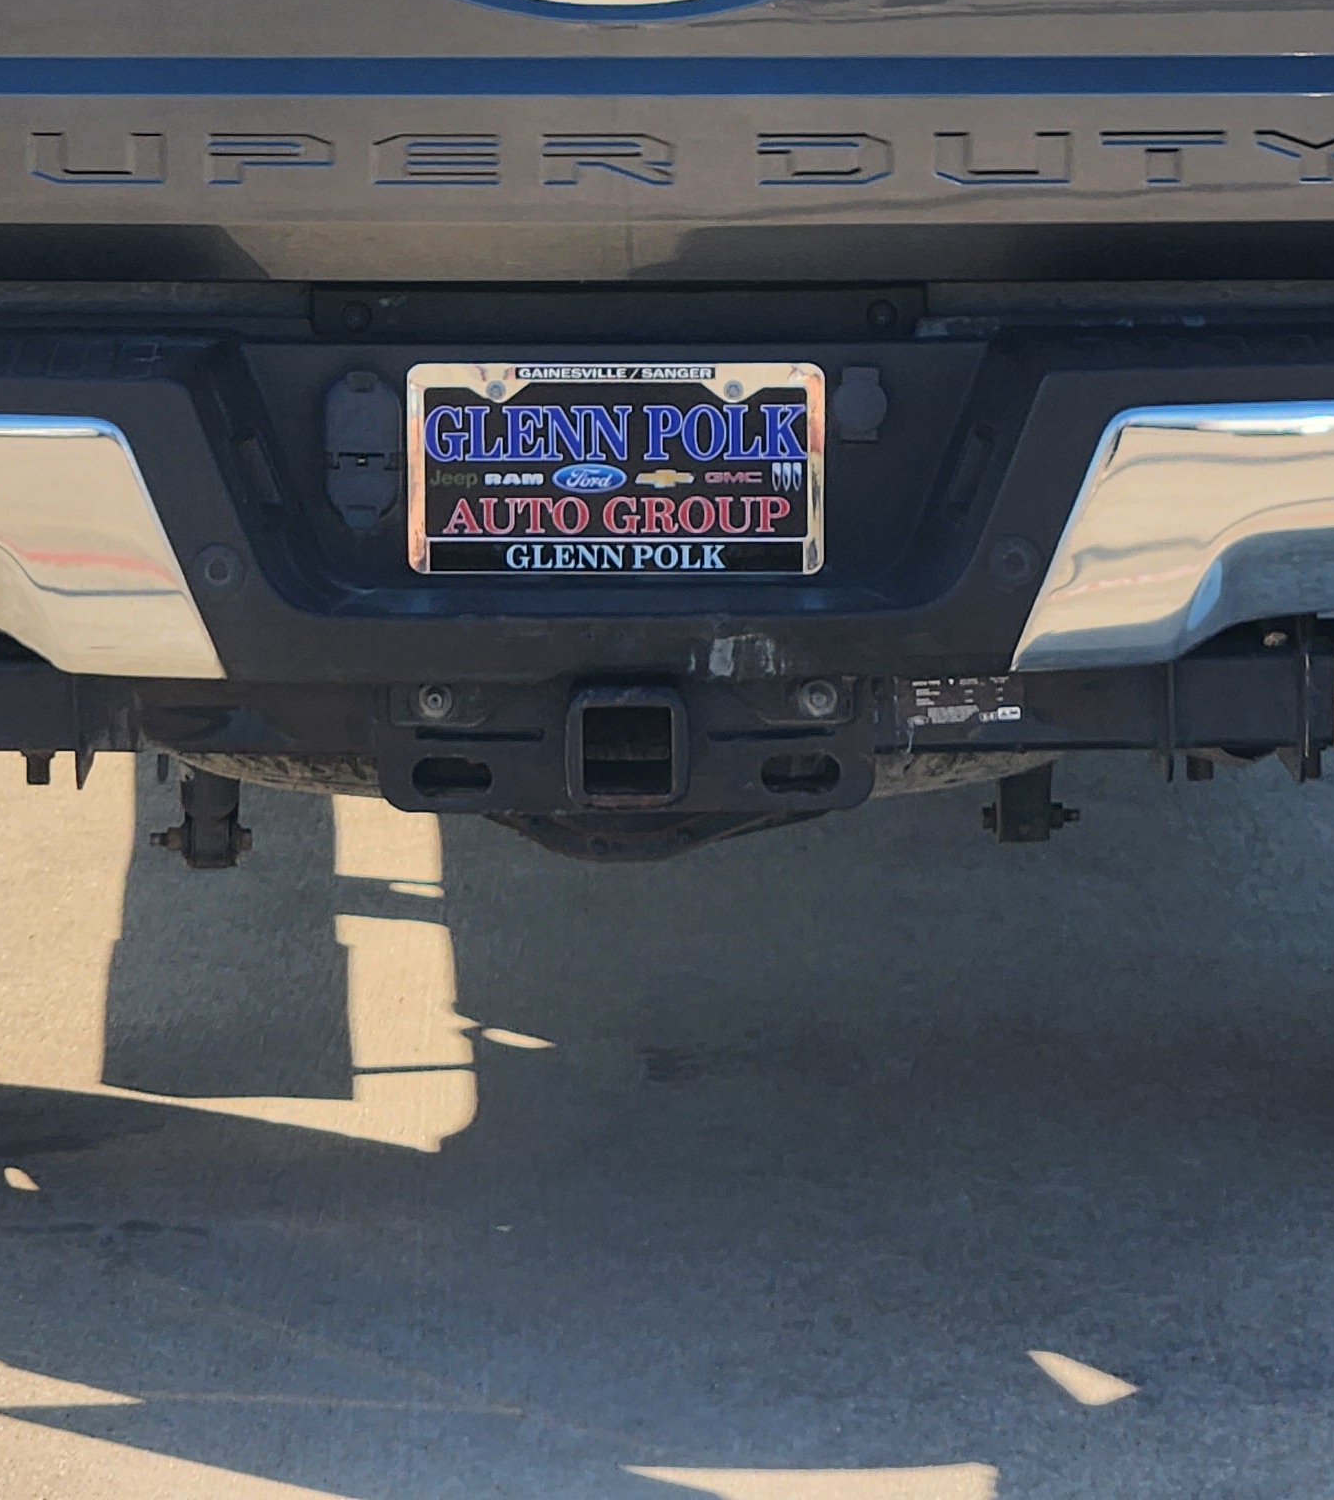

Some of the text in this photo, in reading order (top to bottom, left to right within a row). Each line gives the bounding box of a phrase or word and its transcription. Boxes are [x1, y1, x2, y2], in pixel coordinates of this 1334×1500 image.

[518, 367, 627, 379] GAINESVILLE
[641, 367, 713, 379] SANGER
[424, 403, 809, 462] GLENN POLK
[429, 468, 763, 488] Jeep RAM Ford GMC
[442, 495, 791, 535] AUTO GROUP
[505, 544, 727, 570] GLENN POLK
